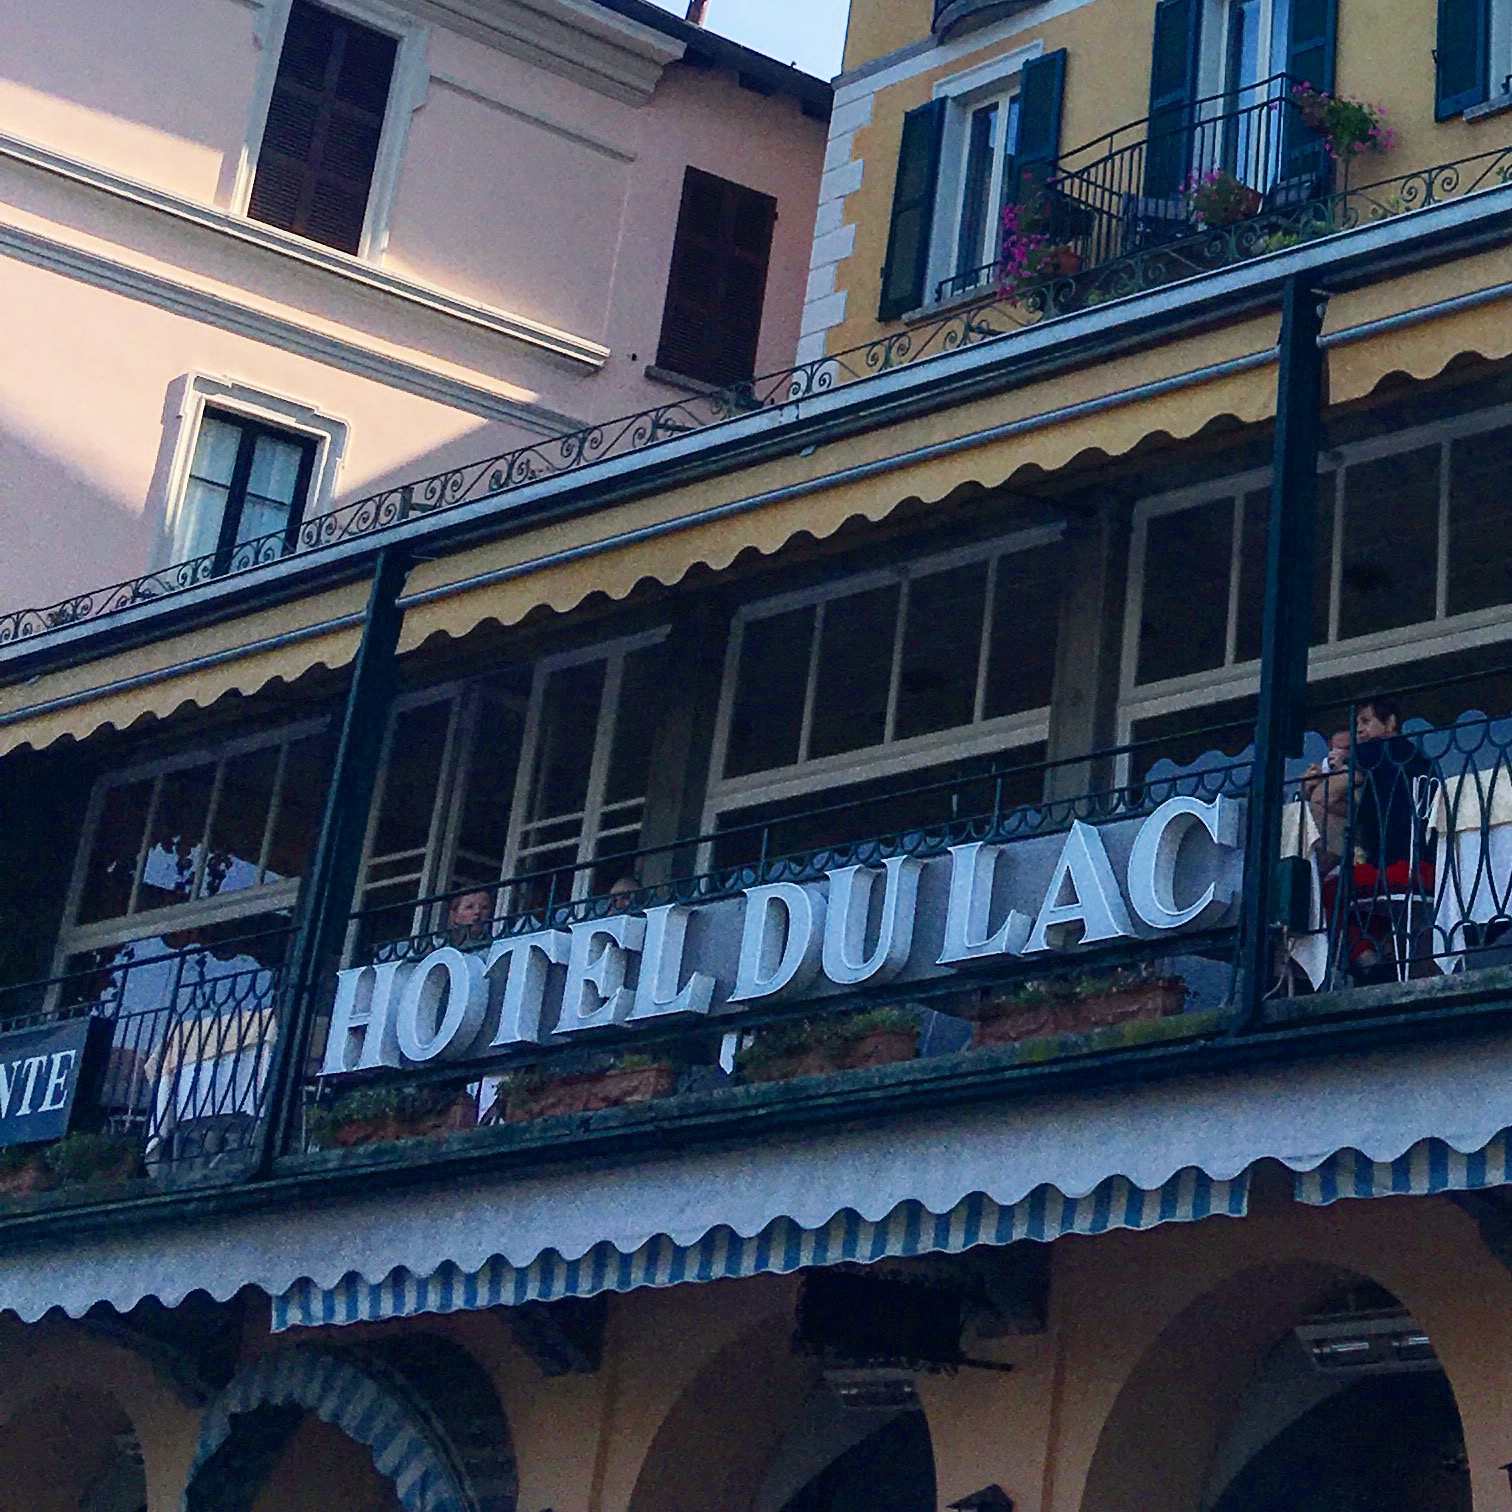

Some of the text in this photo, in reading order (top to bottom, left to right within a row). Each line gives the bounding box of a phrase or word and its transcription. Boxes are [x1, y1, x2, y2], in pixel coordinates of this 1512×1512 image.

[317, 794, 1238, 1076] HOTEL DU LAC
